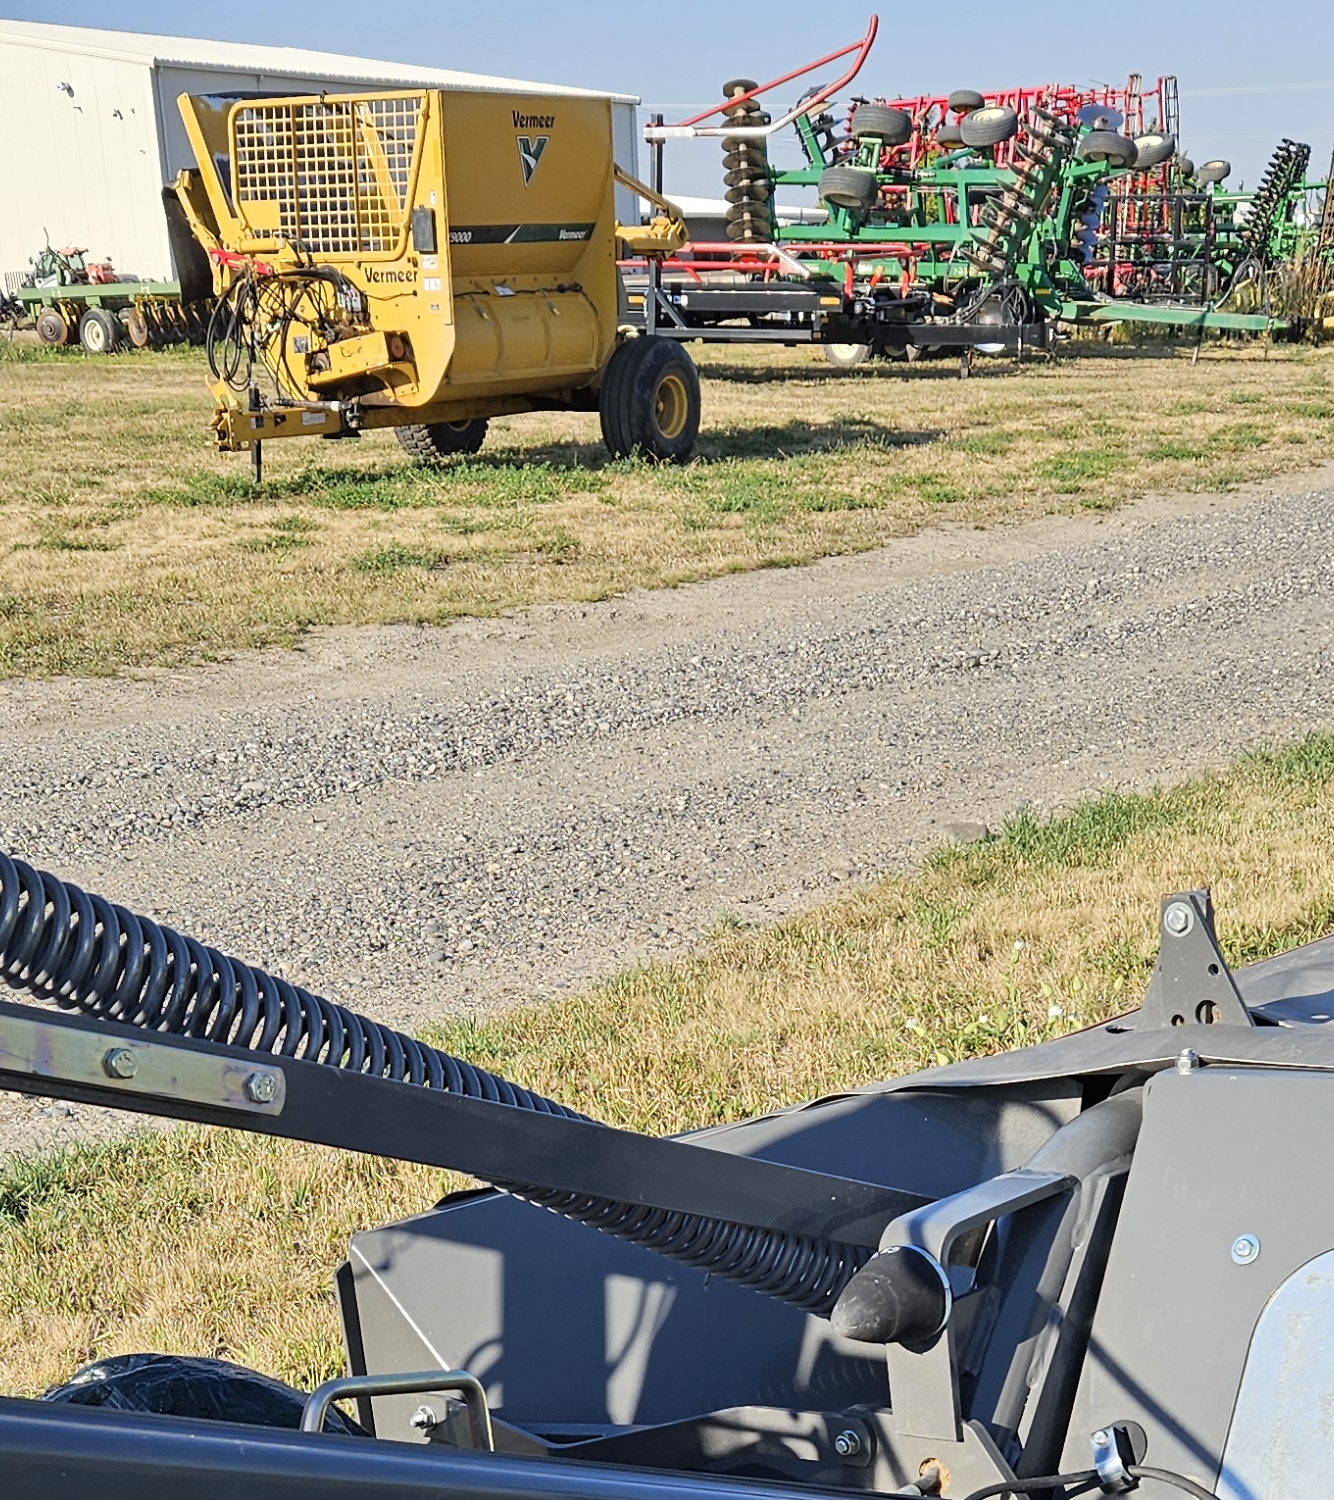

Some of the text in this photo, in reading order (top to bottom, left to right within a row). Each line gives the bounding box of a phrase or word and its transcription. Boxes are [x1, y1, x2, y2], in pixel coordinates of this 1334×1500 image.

[512, 110, 555, 128] Vermeer
[559, 229, 586, 240] Vermeer
[363, 267, 418, 283] Vermeer
